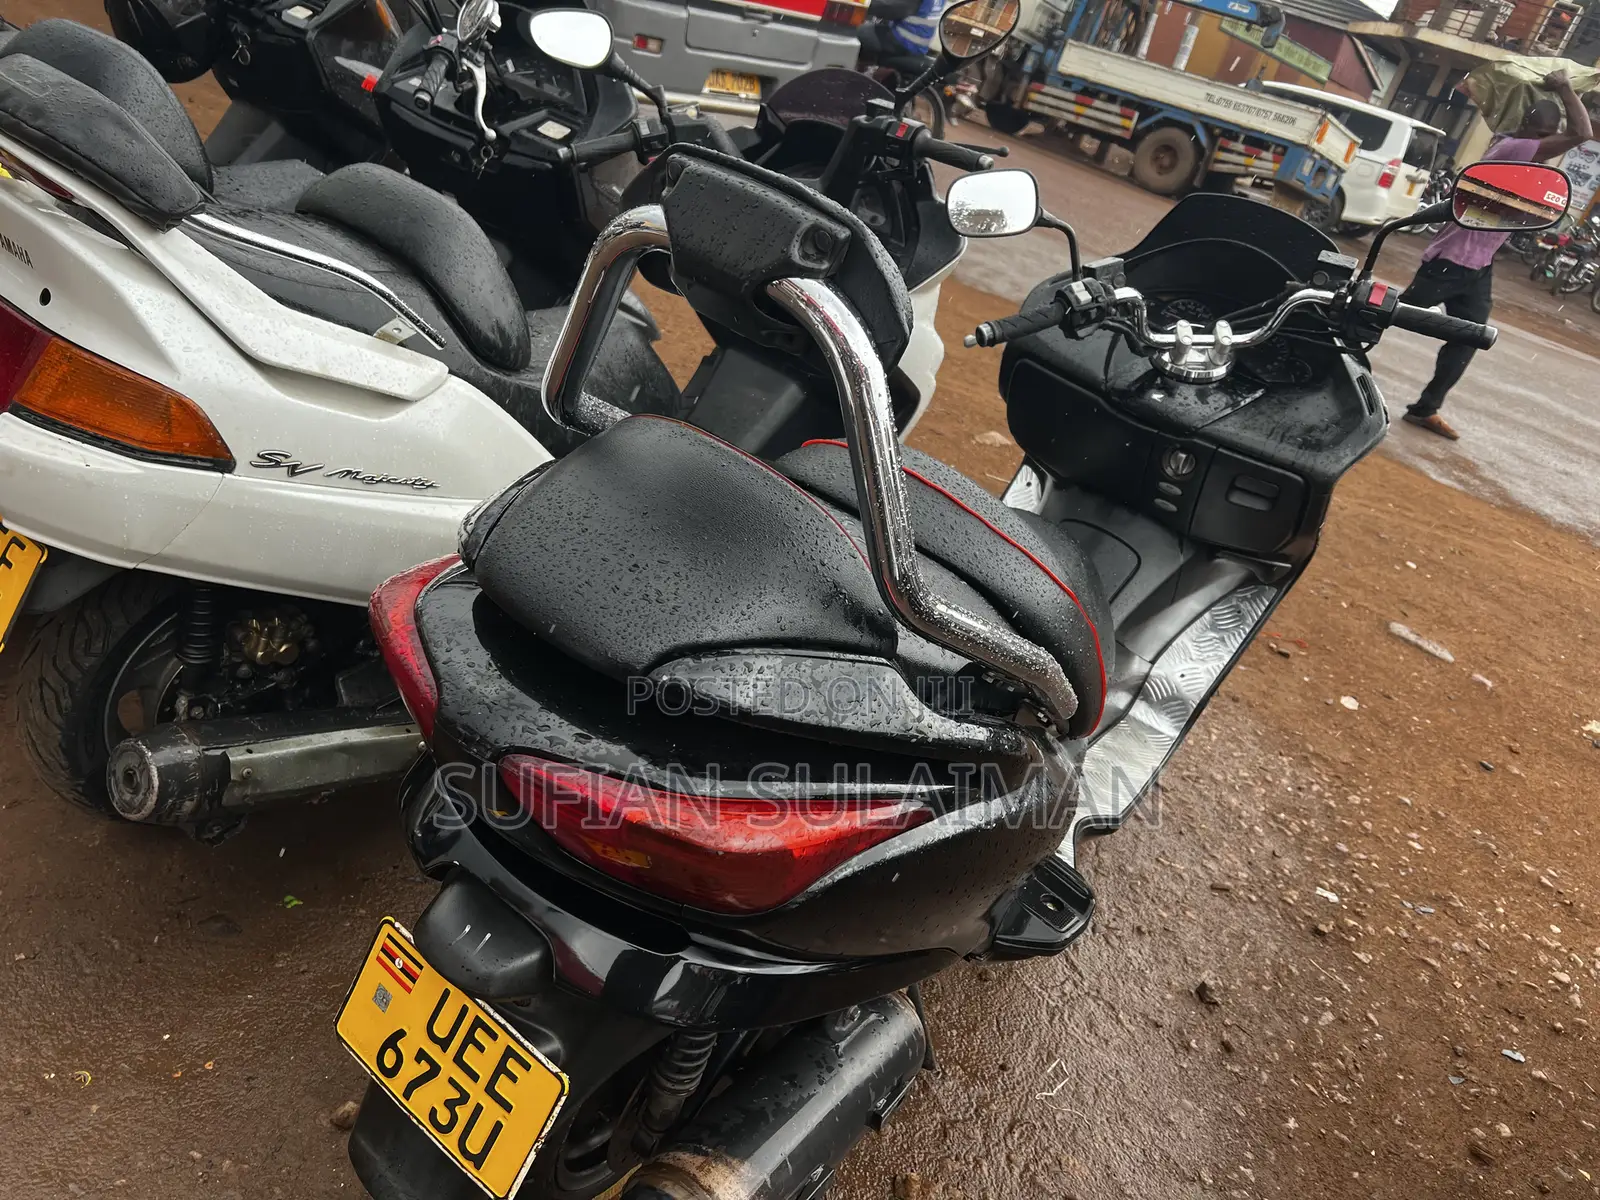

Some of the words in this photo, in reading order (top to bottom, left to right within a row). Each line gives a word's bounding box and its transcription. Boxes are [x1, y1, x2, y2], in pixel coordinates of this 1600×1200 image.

[0, 232, 33, 269] AMAHA
[323, 467, 441, 489] Majesty
[426, 987, 532, 1114] UEE
[376, 1028, 504, 1171] 673U
